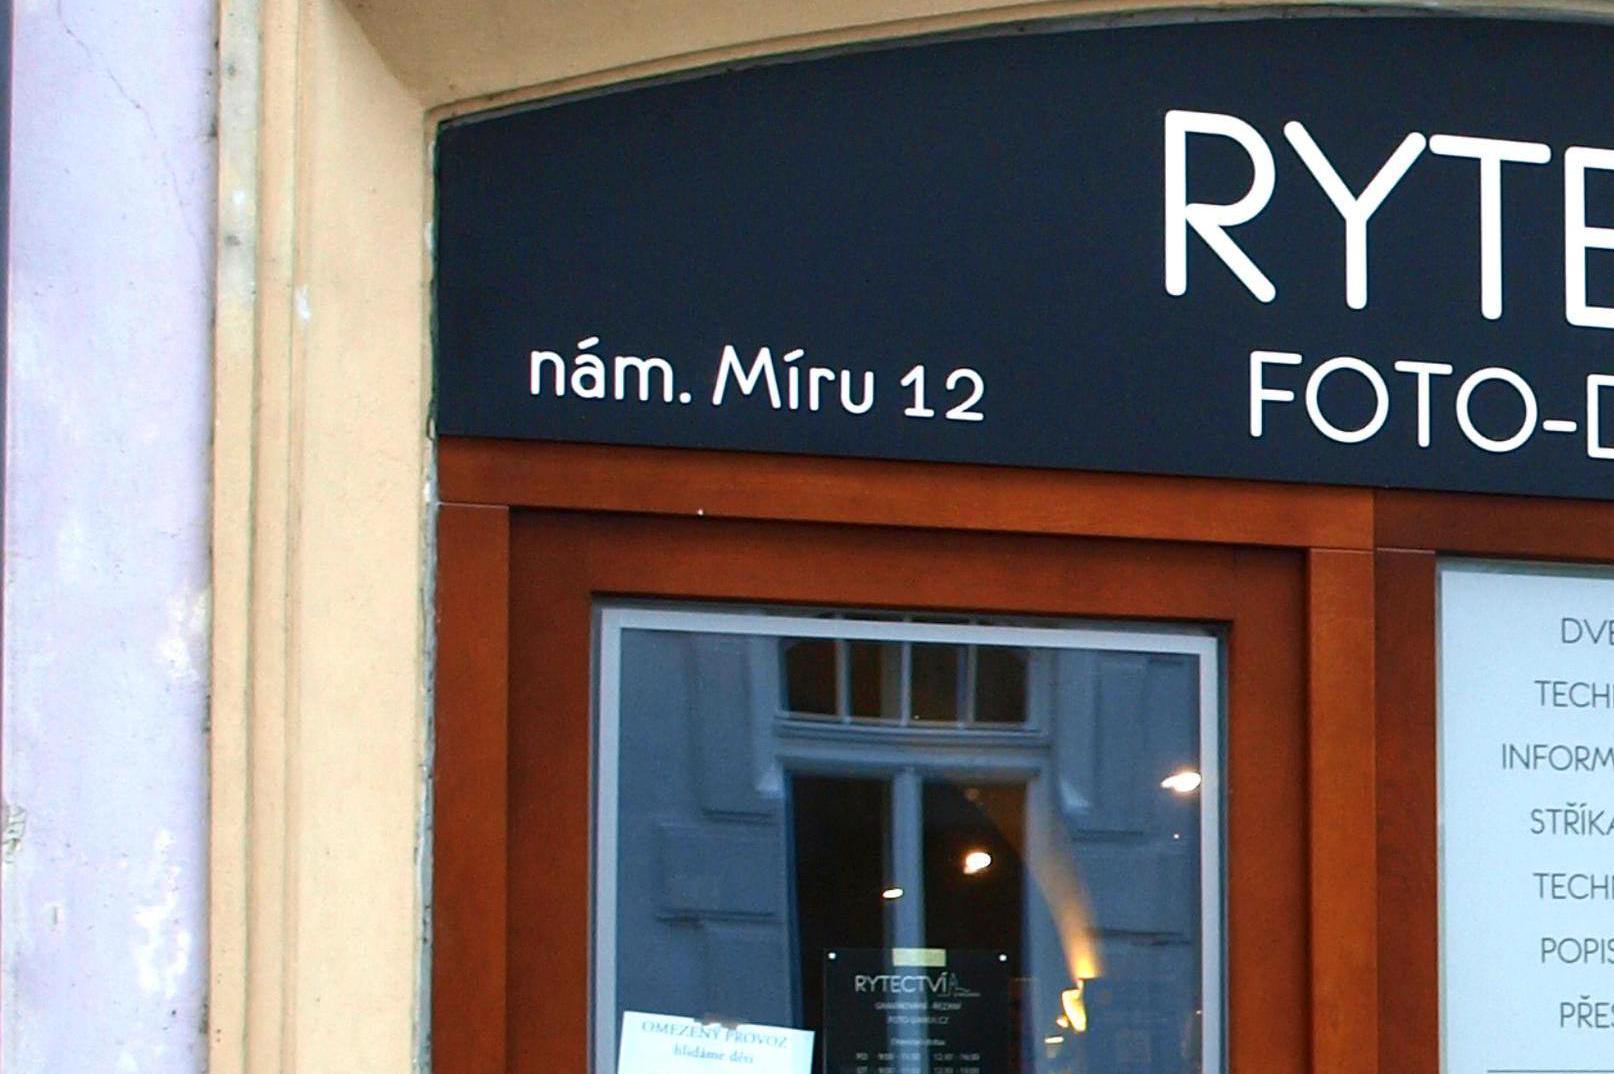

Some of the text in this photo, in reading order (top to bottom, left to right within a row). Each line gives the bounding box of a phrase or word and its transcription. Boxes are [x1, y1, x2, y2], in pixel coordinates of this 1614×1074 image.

[529, 337, 985, 421] nám. Míru 12
